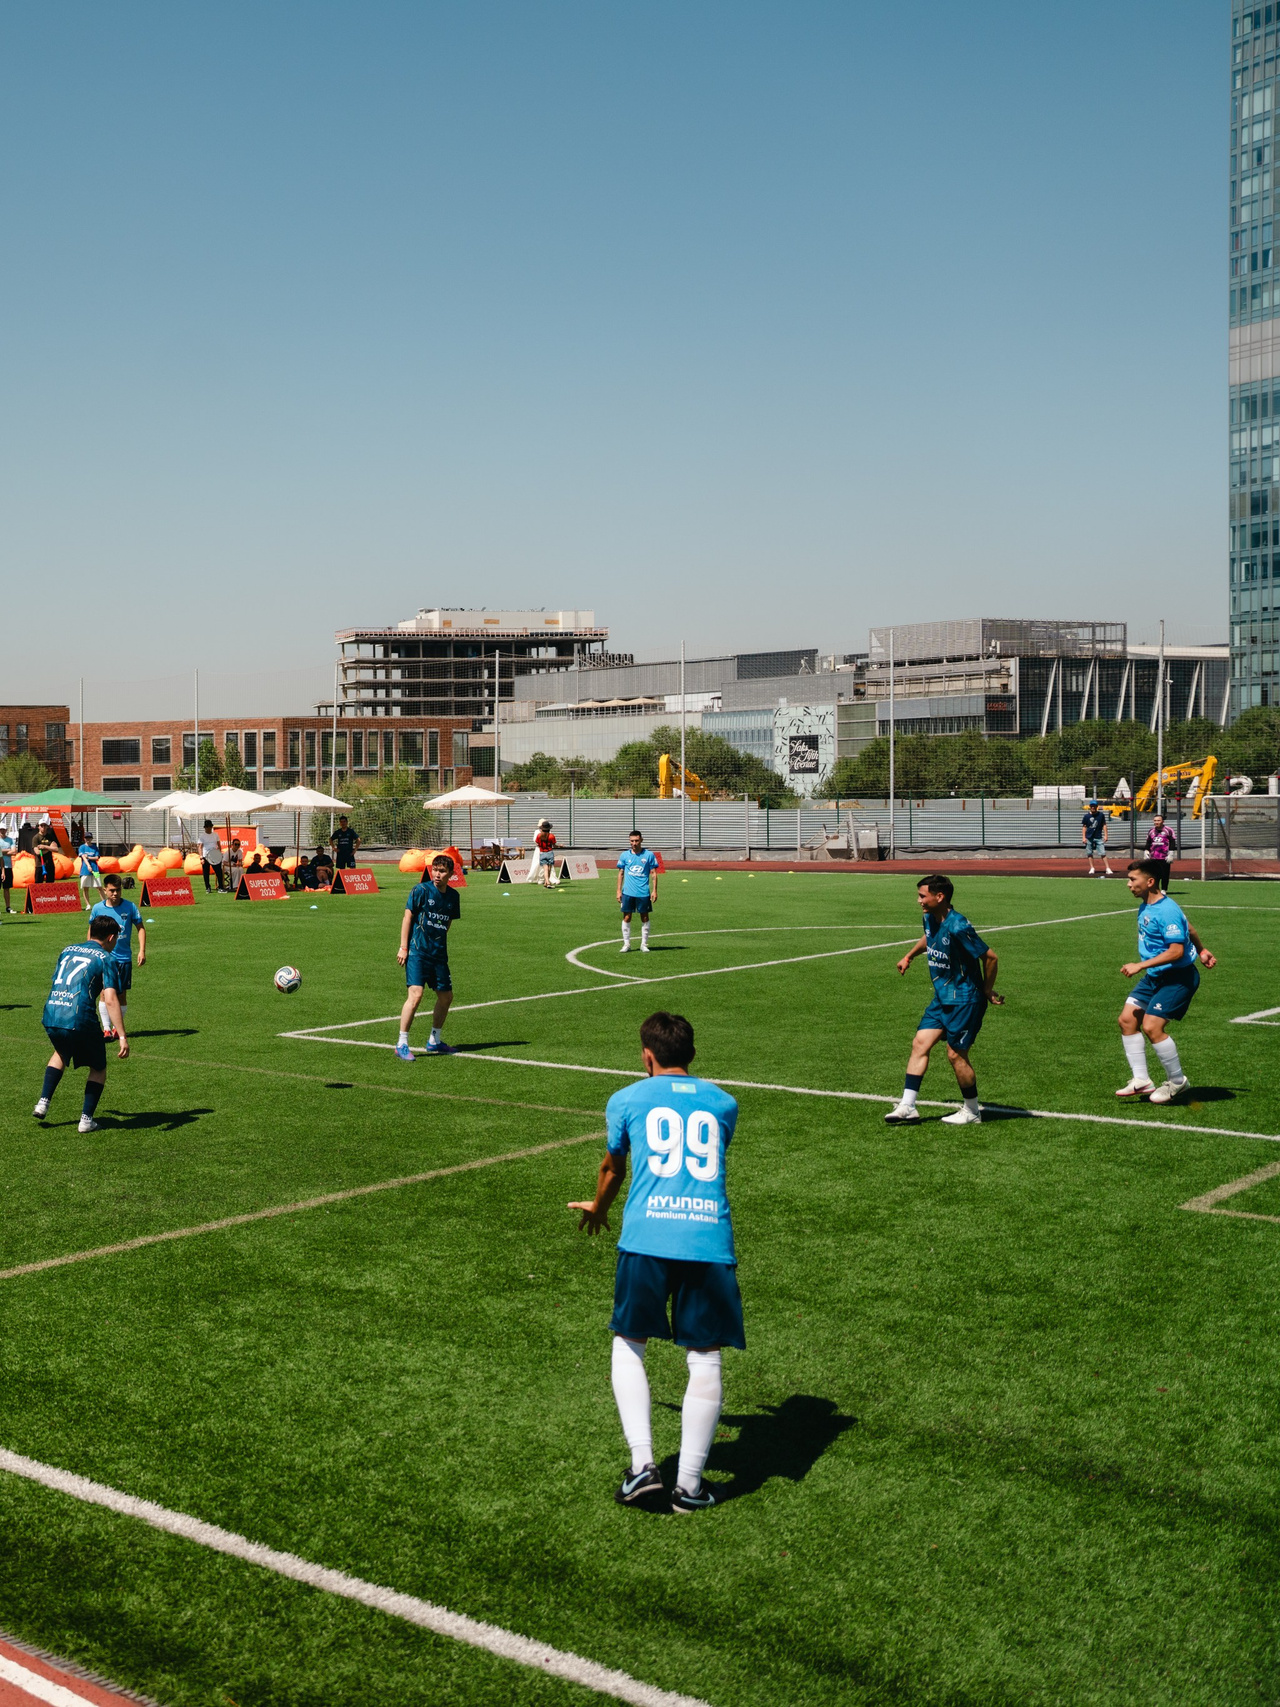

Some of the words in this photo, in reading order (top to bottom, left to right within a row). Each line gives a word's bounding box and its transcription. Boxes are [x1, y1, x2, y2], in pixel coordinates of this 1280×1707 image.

[249, 880, 269, 888] SUPER
[268, 878, 281, 887] CUP
[344, 874, 361, 883] SUPER
[361, 873, 372, 882] CUP
[259, 888, 276, 897] 2026
[354, 882, 369, 890] 2026
[927, 946, 949, 959] OYOTA
[54, 955, 91, 986] 17
[51, 990, 74, 999] TOYOTA
[960, 1029, 968, 1044] 7
[646, 1106, 720, 1182] 99
[648, 1195, 718, 1212] HYUNDAI
[646, 1209, 687, 1221] Premium
[688, 1211, 719, 1225] Astana
